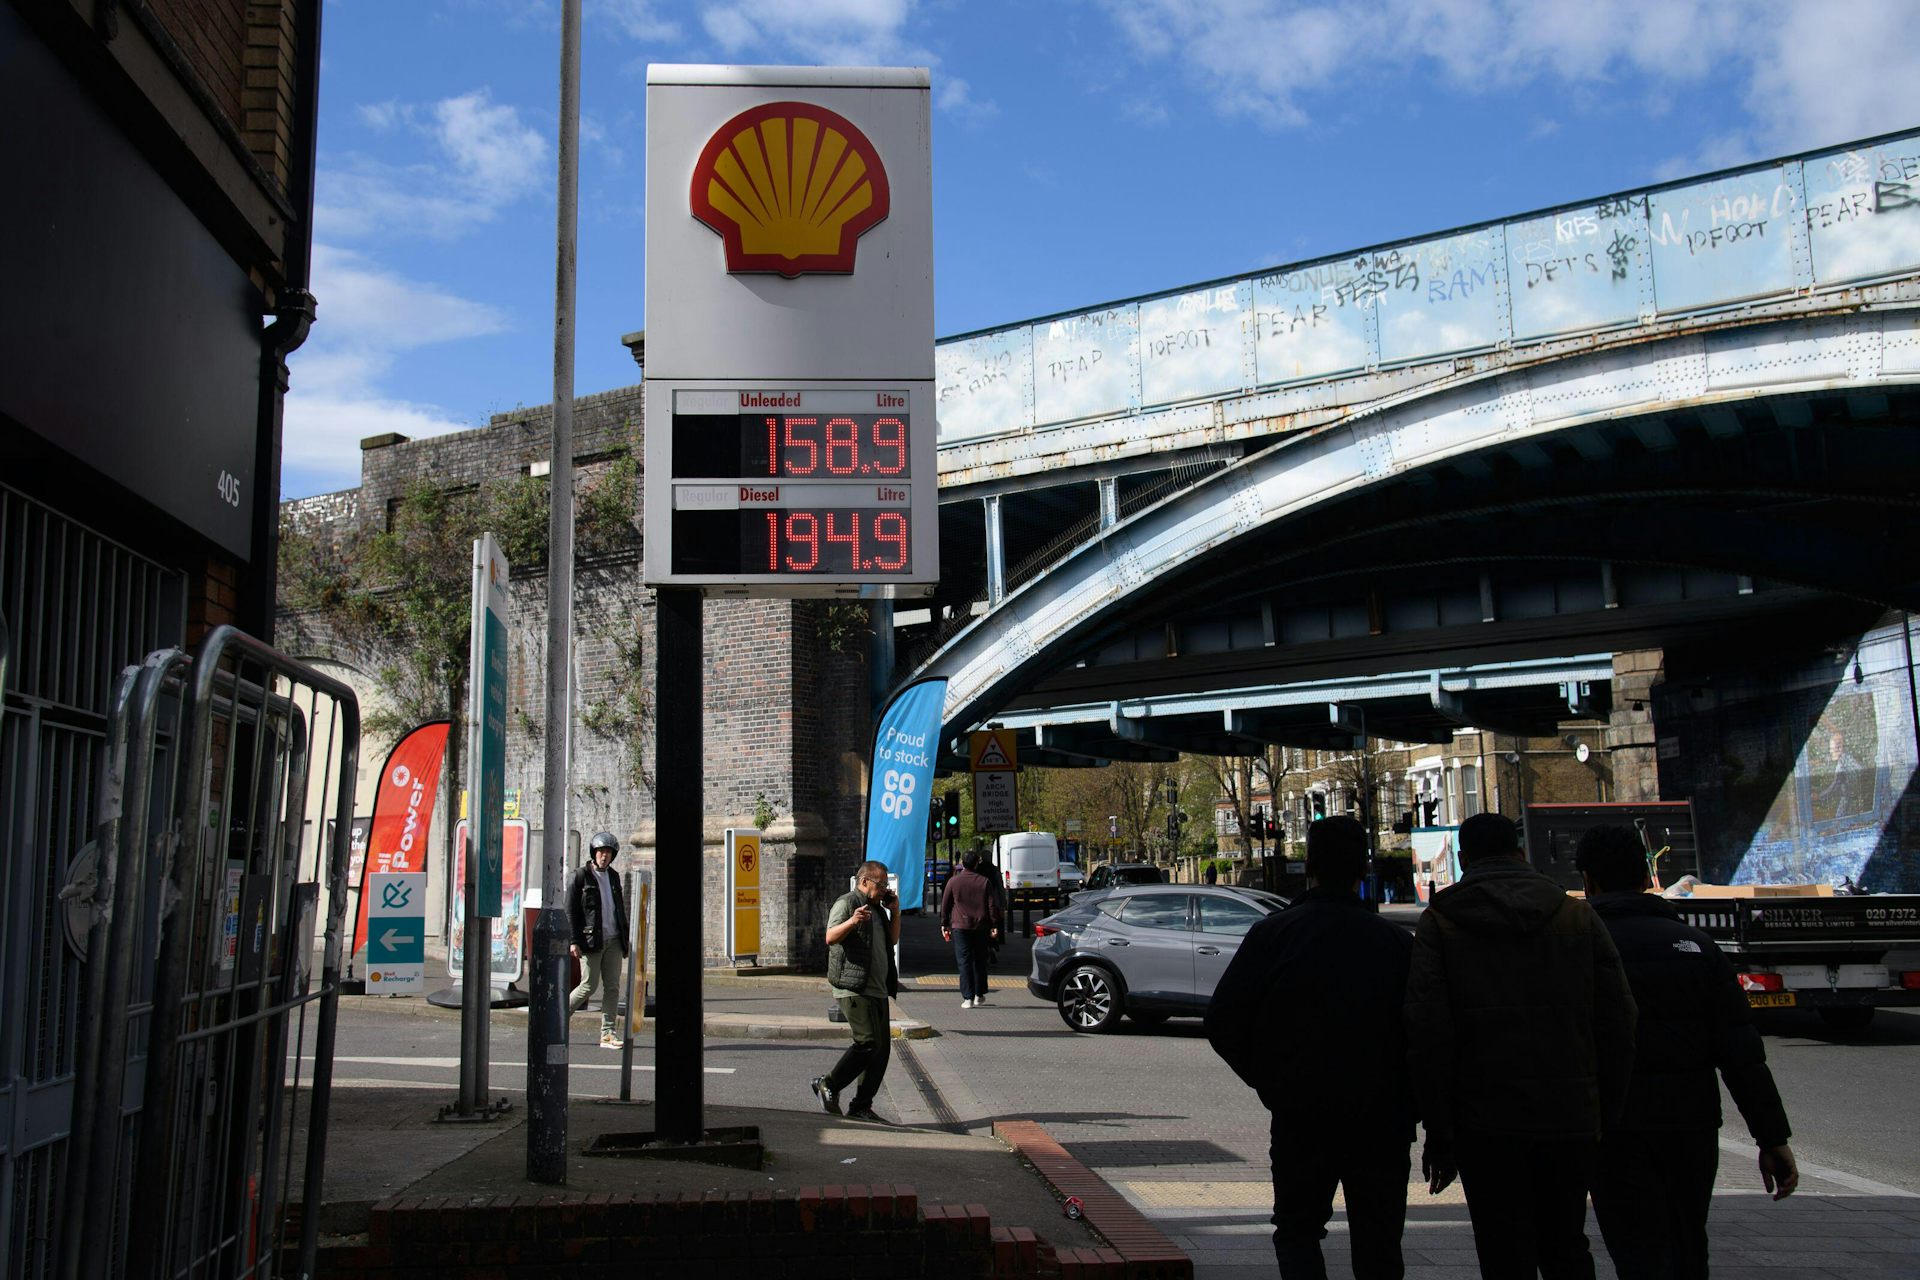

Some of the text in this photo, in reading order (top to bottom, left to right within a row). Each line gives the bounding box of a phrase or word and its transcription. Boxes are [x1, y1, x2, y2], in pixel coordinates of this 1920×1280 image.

[1428, 261, 1497, 304] BAM
[1256, 303, 1328, 341] PEAR
[740, 392, 905, 408] Unleaded Litre
[766, 418, 905, 474] 158.9
[217, 469, 240, 508] 405
[740, 486, 906, 501] Diesel Litre
[766, 512, 907, 570] 194.9
[886, 727, 925, 748] Proud
[879, 746, 929, 768] to stock
[351, 838, 366, 850] the
[1764, 908, 1823, 921] SILVER
[1865, 908, 1886, 919] 020
[1888, 908, 1917, 919] 7372
